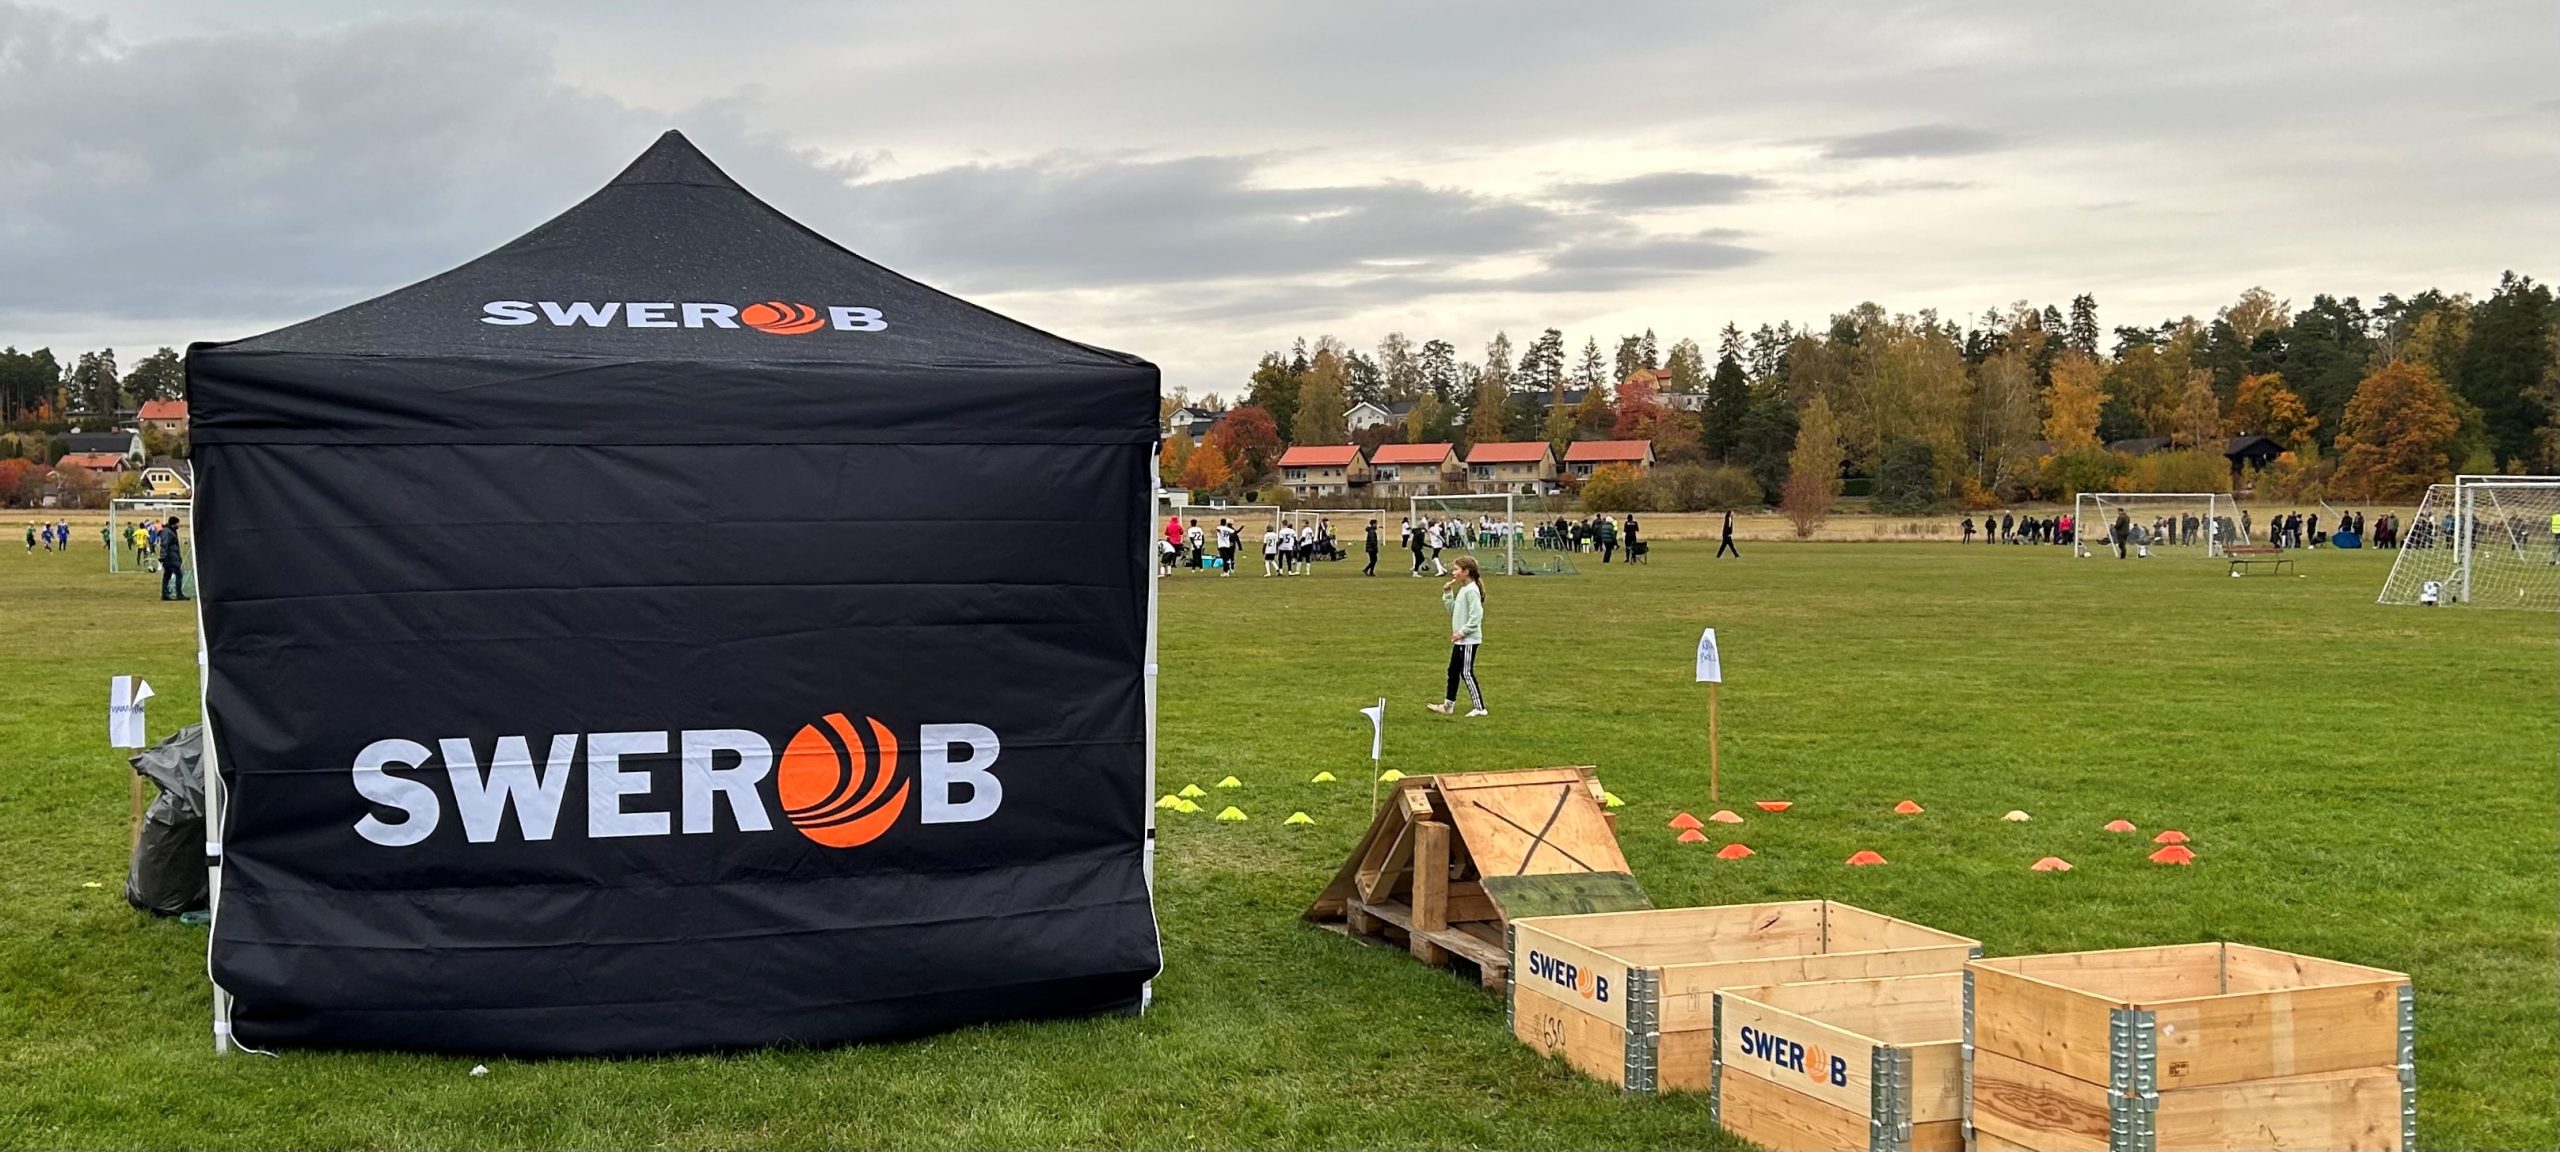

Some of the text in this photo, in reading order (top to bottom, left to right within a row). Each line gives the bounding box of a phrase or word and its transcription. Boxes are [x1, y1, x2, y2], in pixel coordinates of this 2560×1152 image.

[480, 300, 888, 336] SWEROB
[352, 713, 1003, 848] SWEROB
[1529, 950, 1609, 1003] SWEROB
[1740, 1026, 1847, 1087] SWEROB
